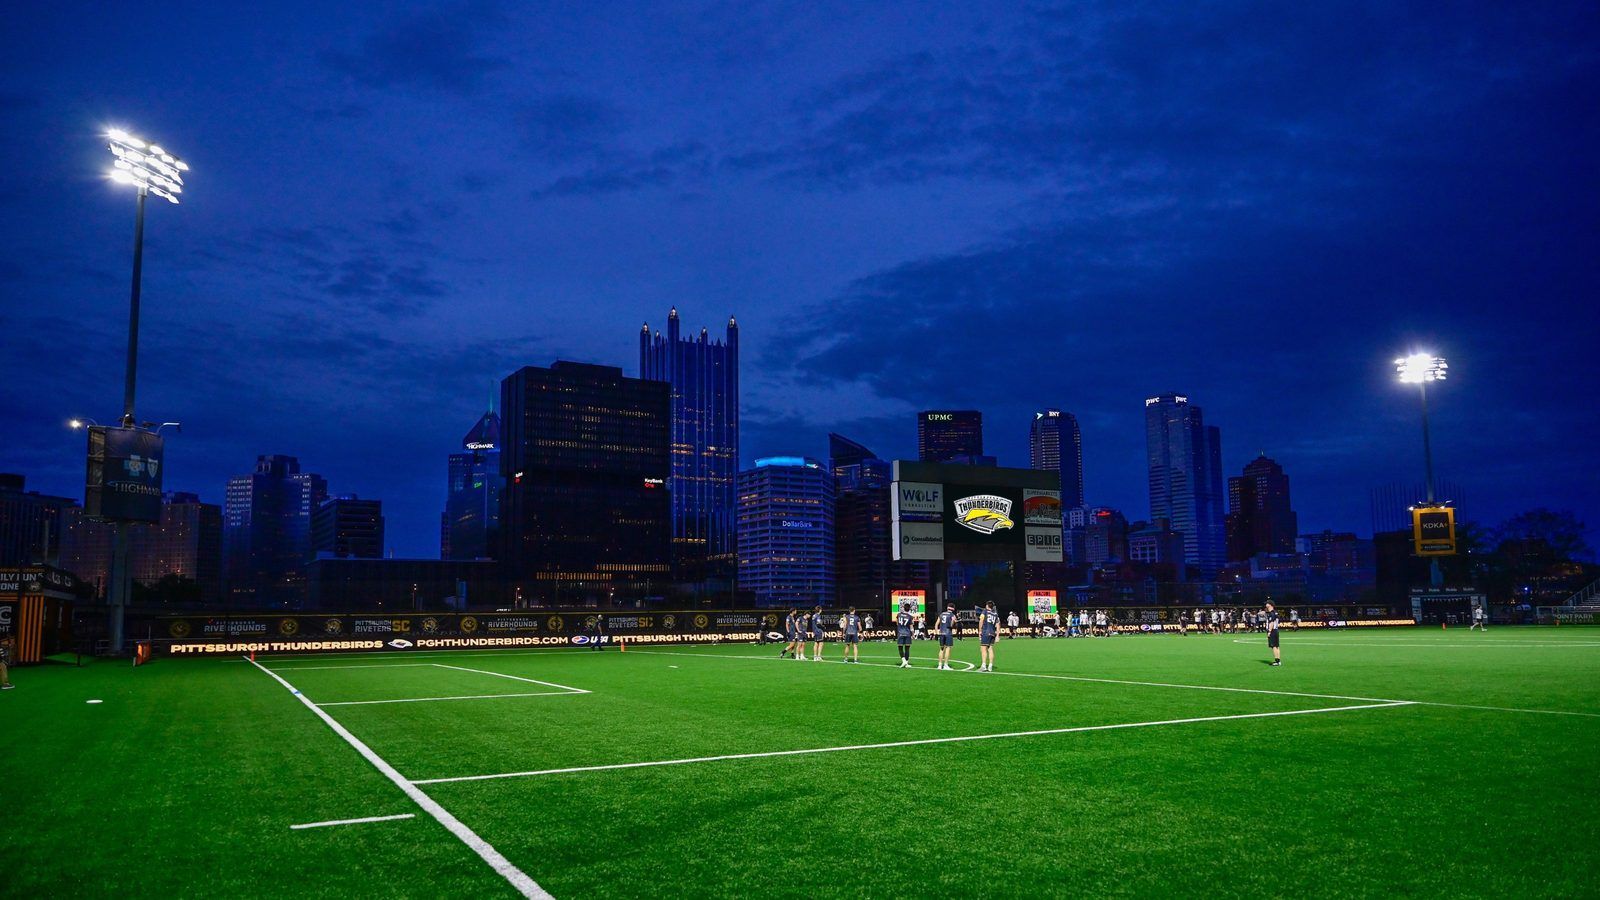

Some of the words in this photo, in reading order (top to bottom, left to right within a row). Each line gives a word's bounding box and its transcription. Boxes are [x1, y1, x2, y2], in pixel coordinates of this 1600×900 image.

[1145, 397, 1160, 407] pwc
[467, 442, 494, 450] HIGHMARK
[902, 489, 939, 502] WOLF
[958, 500, 1008, 514] THUNDERBIRDS
[1027, 535, 1061, 545] EPIC
[488, 620, 538, 628] RIVERHOUNDS
[849, 618, 855, 626] 2
[898, 618, 909, 626] 47
[941, 615, 947, 624] 3
[986, 614, 996, 624] 24
[355, 625, 391, 633] RIVETERS
[391, 619, 411, 632] SC
[171, 642, 269, 653] PITTSBURGH
[271, 640, 383, 651] THUNDERBIRDS
[417, 636, 568, 648] PGHTHUNDERBIRDS.COM
[612, 633, 682, 643] PITTSBURGH
